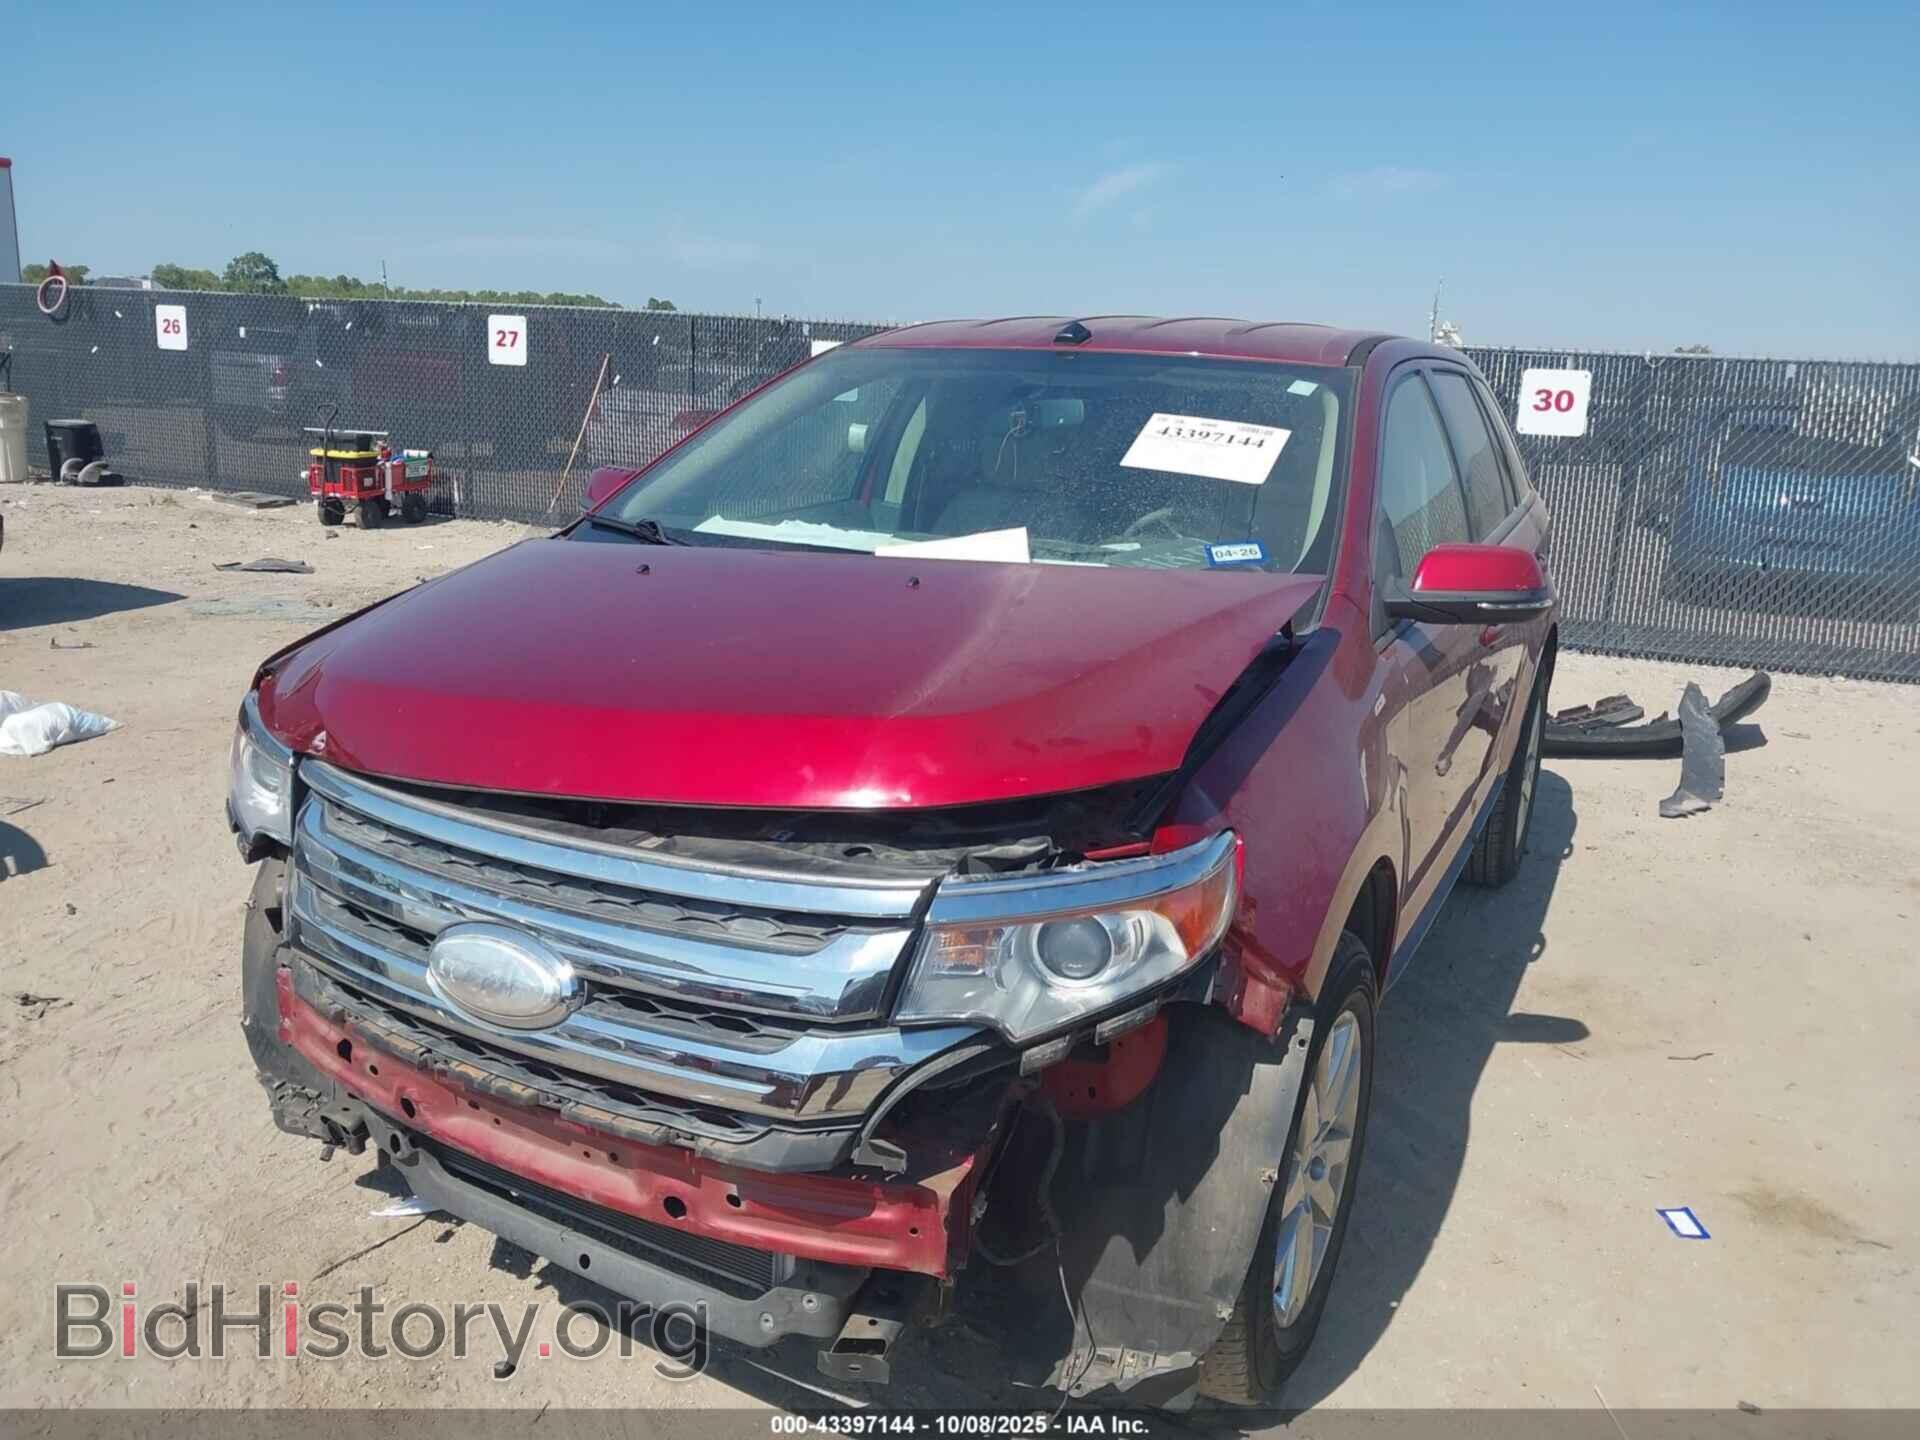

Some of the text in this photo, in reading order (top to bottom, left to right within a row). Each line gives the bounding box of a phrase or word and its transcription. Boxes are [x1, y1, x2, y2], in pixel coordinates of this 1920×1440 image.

[162, 318, 181, 334] 26
[496, 329, 518, 347] 27
[1532, 389, 1575, 413] 30
[1156, 426, 1265, 448] 43397144
[1214, 548, 1259, 559] 04-26
